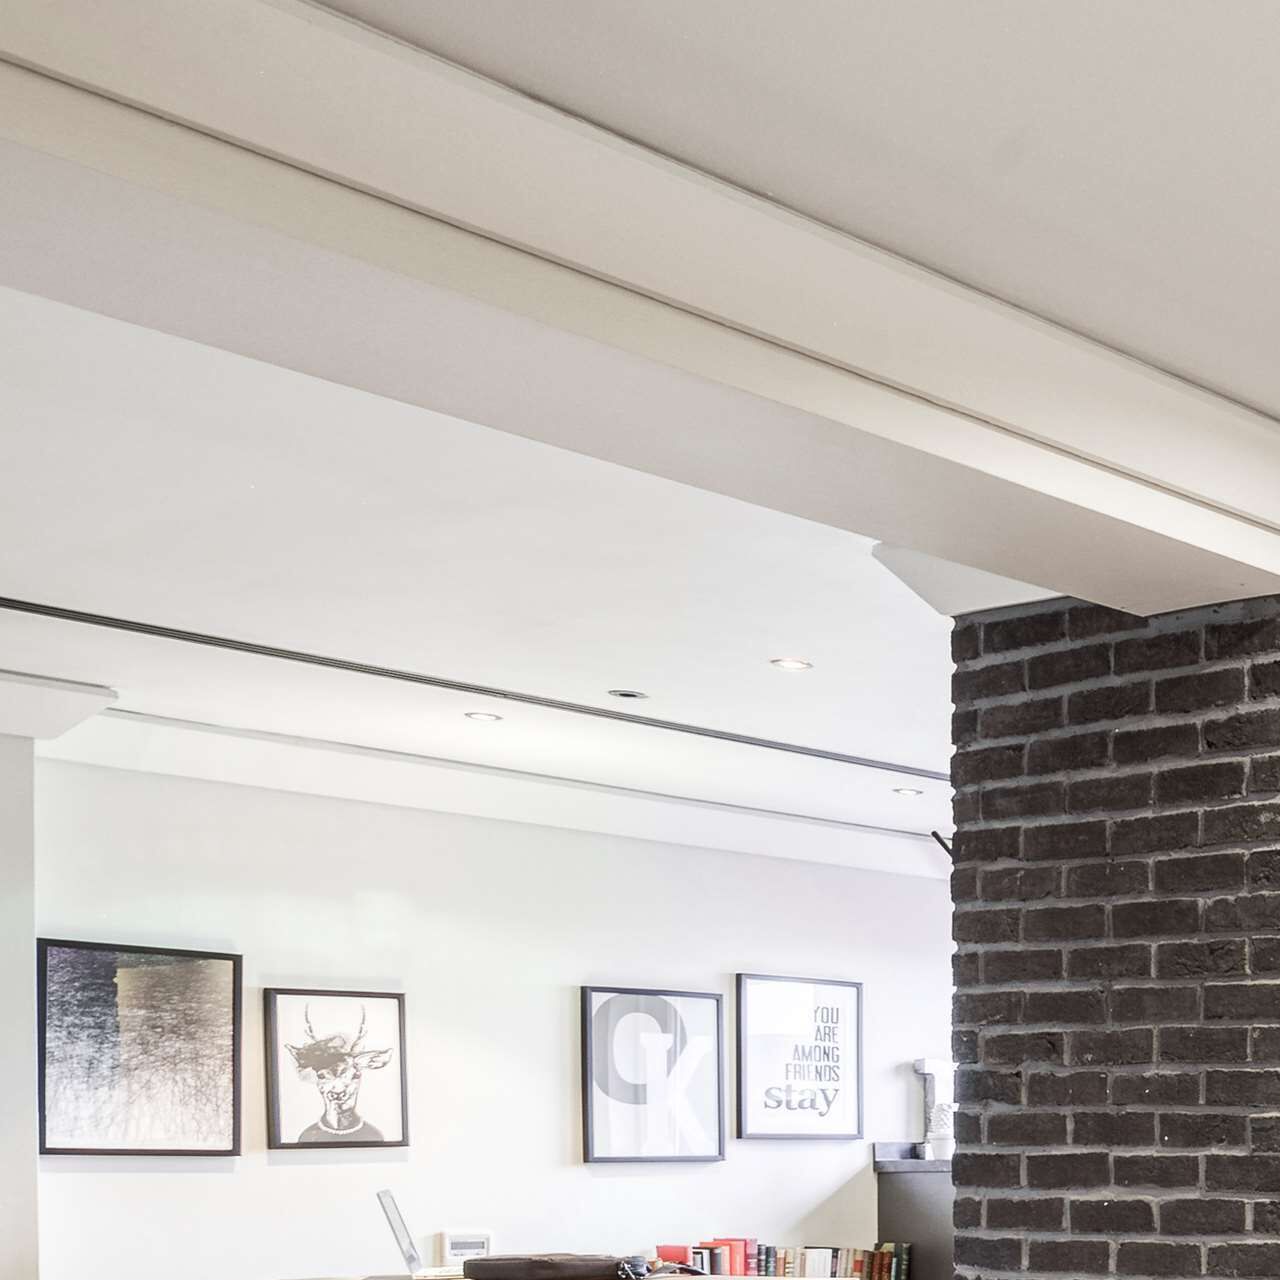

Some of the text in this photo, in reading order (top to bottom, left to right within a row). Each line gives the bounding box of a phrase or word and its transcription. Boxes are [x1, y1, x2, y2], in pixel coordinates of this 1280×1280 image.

[813, 1006, 839, 1025] YOU
[814, 1025, 839, 1043] ARE
[792, 1044, 840, 1063] AMONG
[785, 1063, 840, 1082] FRIENDS
[764, 1084, 840, 1117] stay
